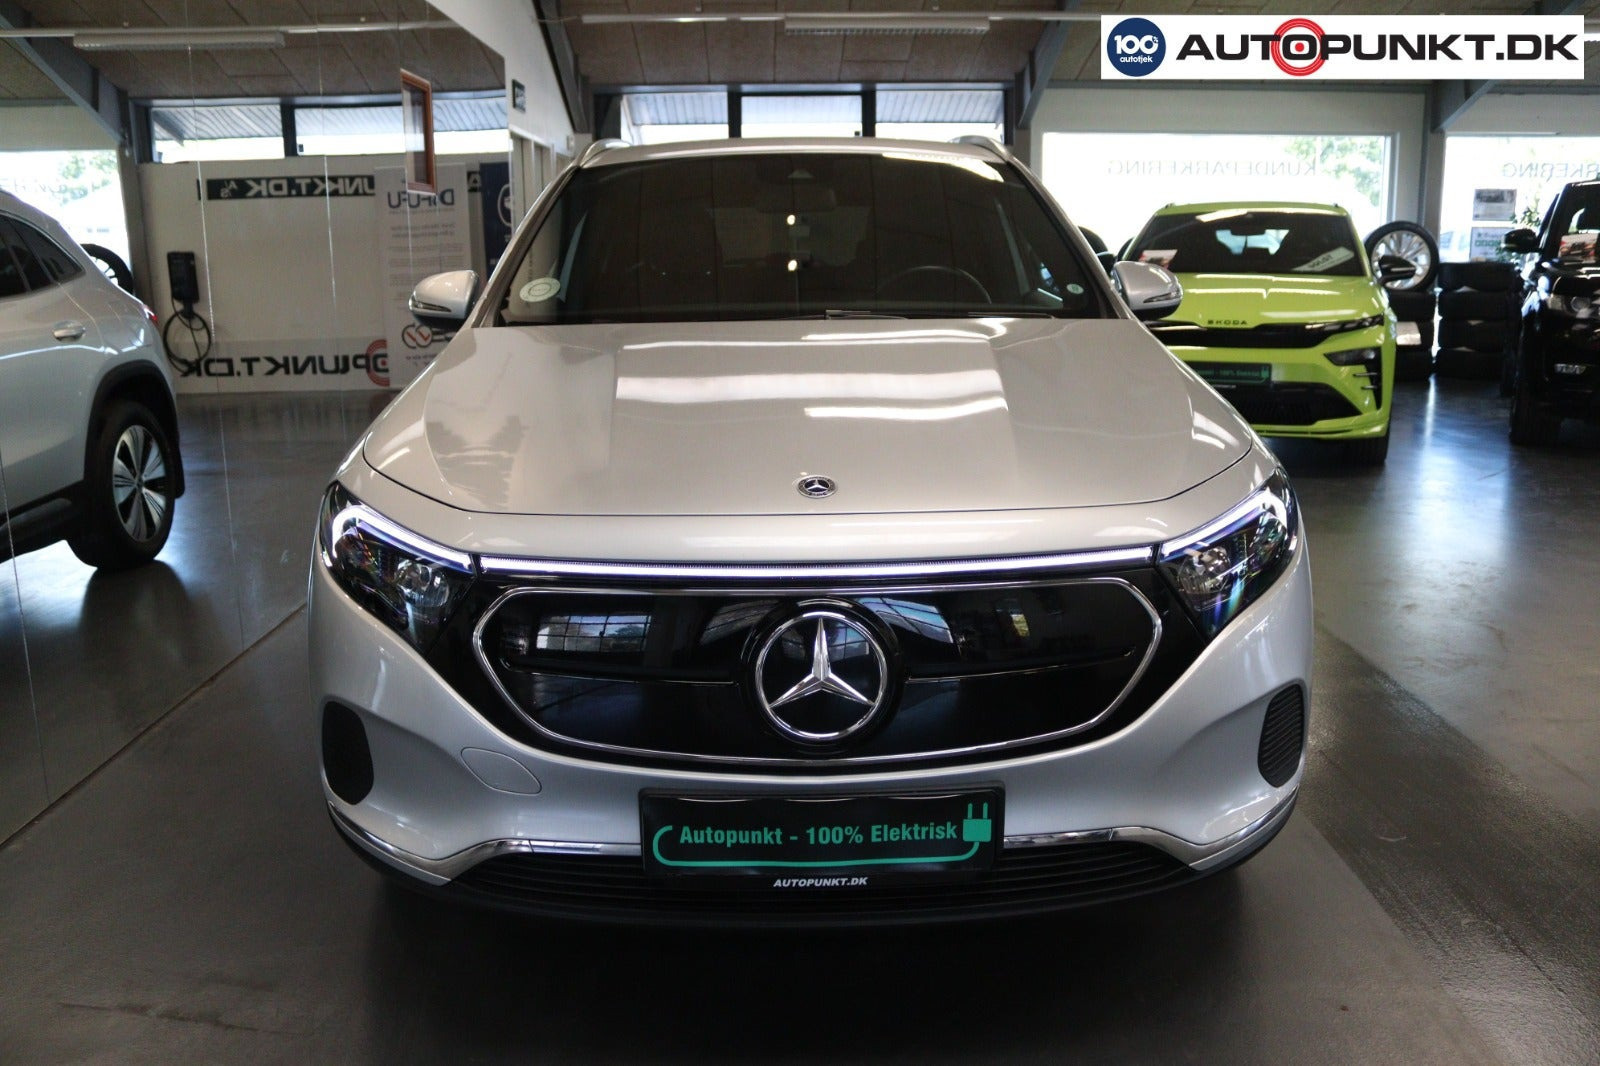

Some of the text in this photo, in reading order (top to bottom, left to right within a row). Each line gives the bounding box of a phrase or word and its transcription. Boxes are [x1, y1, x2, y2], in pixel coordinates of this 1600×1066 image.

[679, 825, 783, 848] Autopunkt
[806, 825, 864, 845] 100%
[871, 821, 958, 843] Elektrisk
[773, 876, 868, 888] AUTOPUNKT.DK
